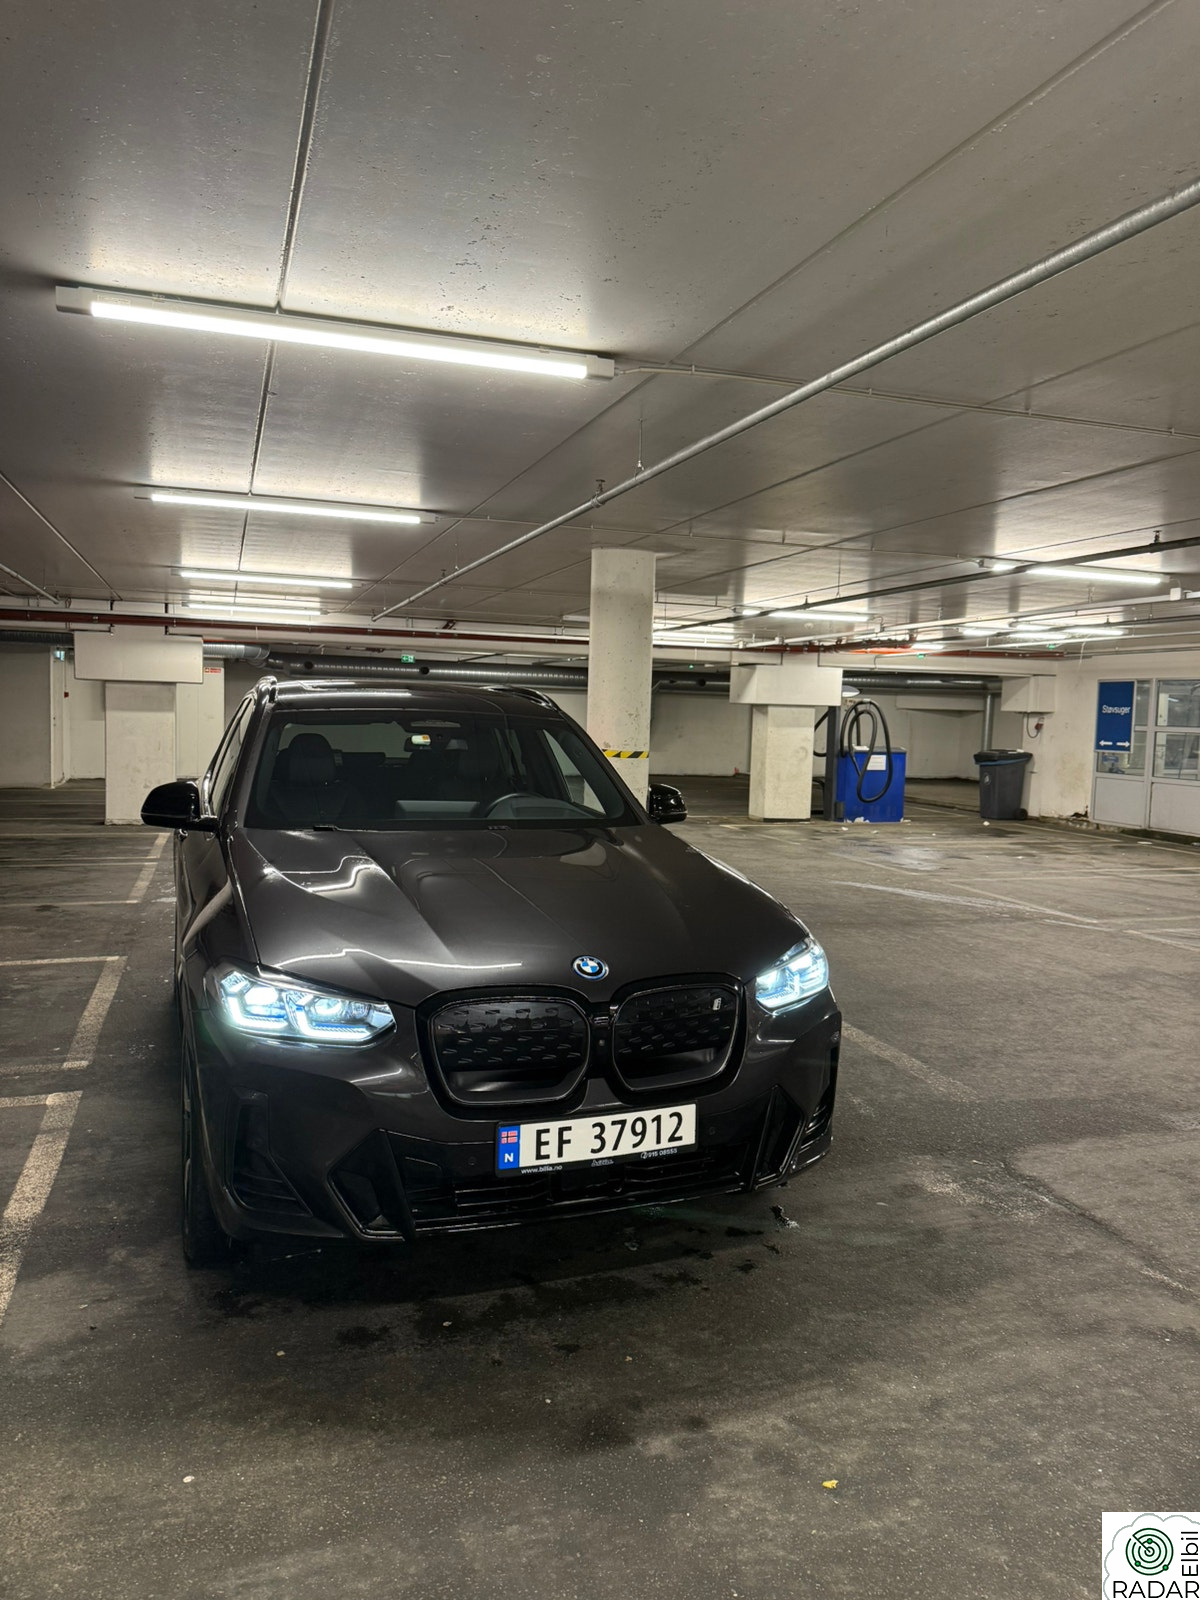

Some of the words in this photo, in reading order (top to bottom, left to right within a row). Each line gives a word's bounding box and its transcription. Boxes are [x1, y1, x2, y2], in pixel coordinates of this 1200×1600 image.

[1101, 704, 1131, 715] Støvsuger
[535, 1126, 572, 1161] EF
[590, 1111, 684, 1154] 37912
[504, 1152, 514, 1163] N
